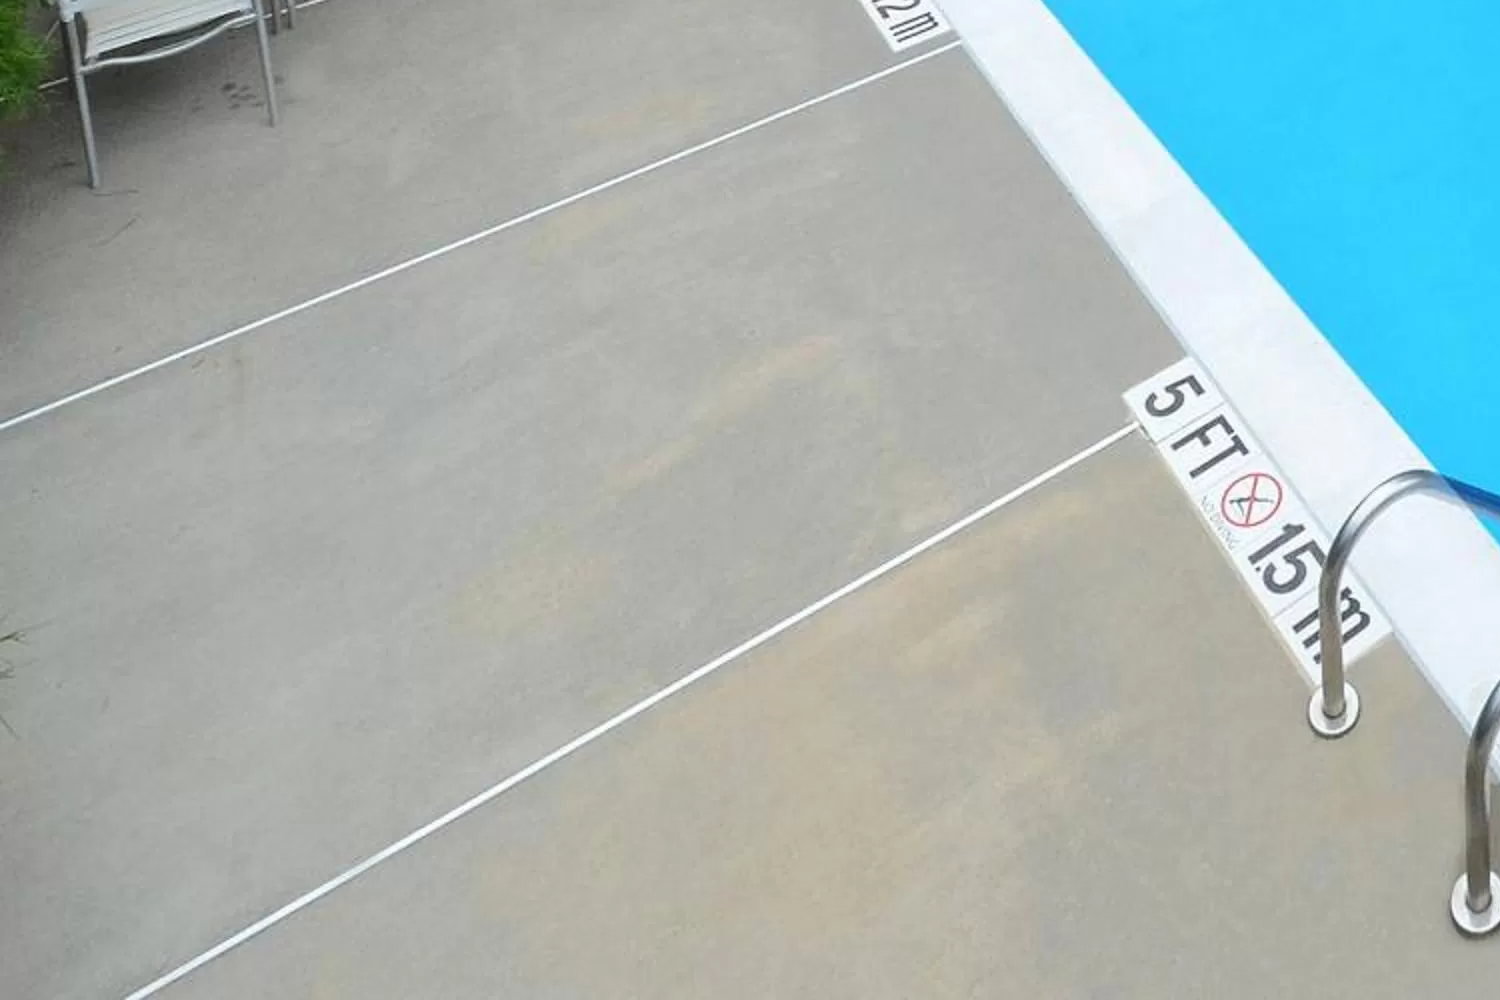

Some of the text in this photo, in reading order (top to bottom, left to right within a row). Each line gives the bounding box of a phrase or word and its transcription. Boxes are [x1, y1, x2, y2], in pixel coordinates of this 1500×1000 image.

[888, 11, 939, 43] m
[1145, 374, 1205, 417] 5
[1170, 413, 1249, 479] FT
